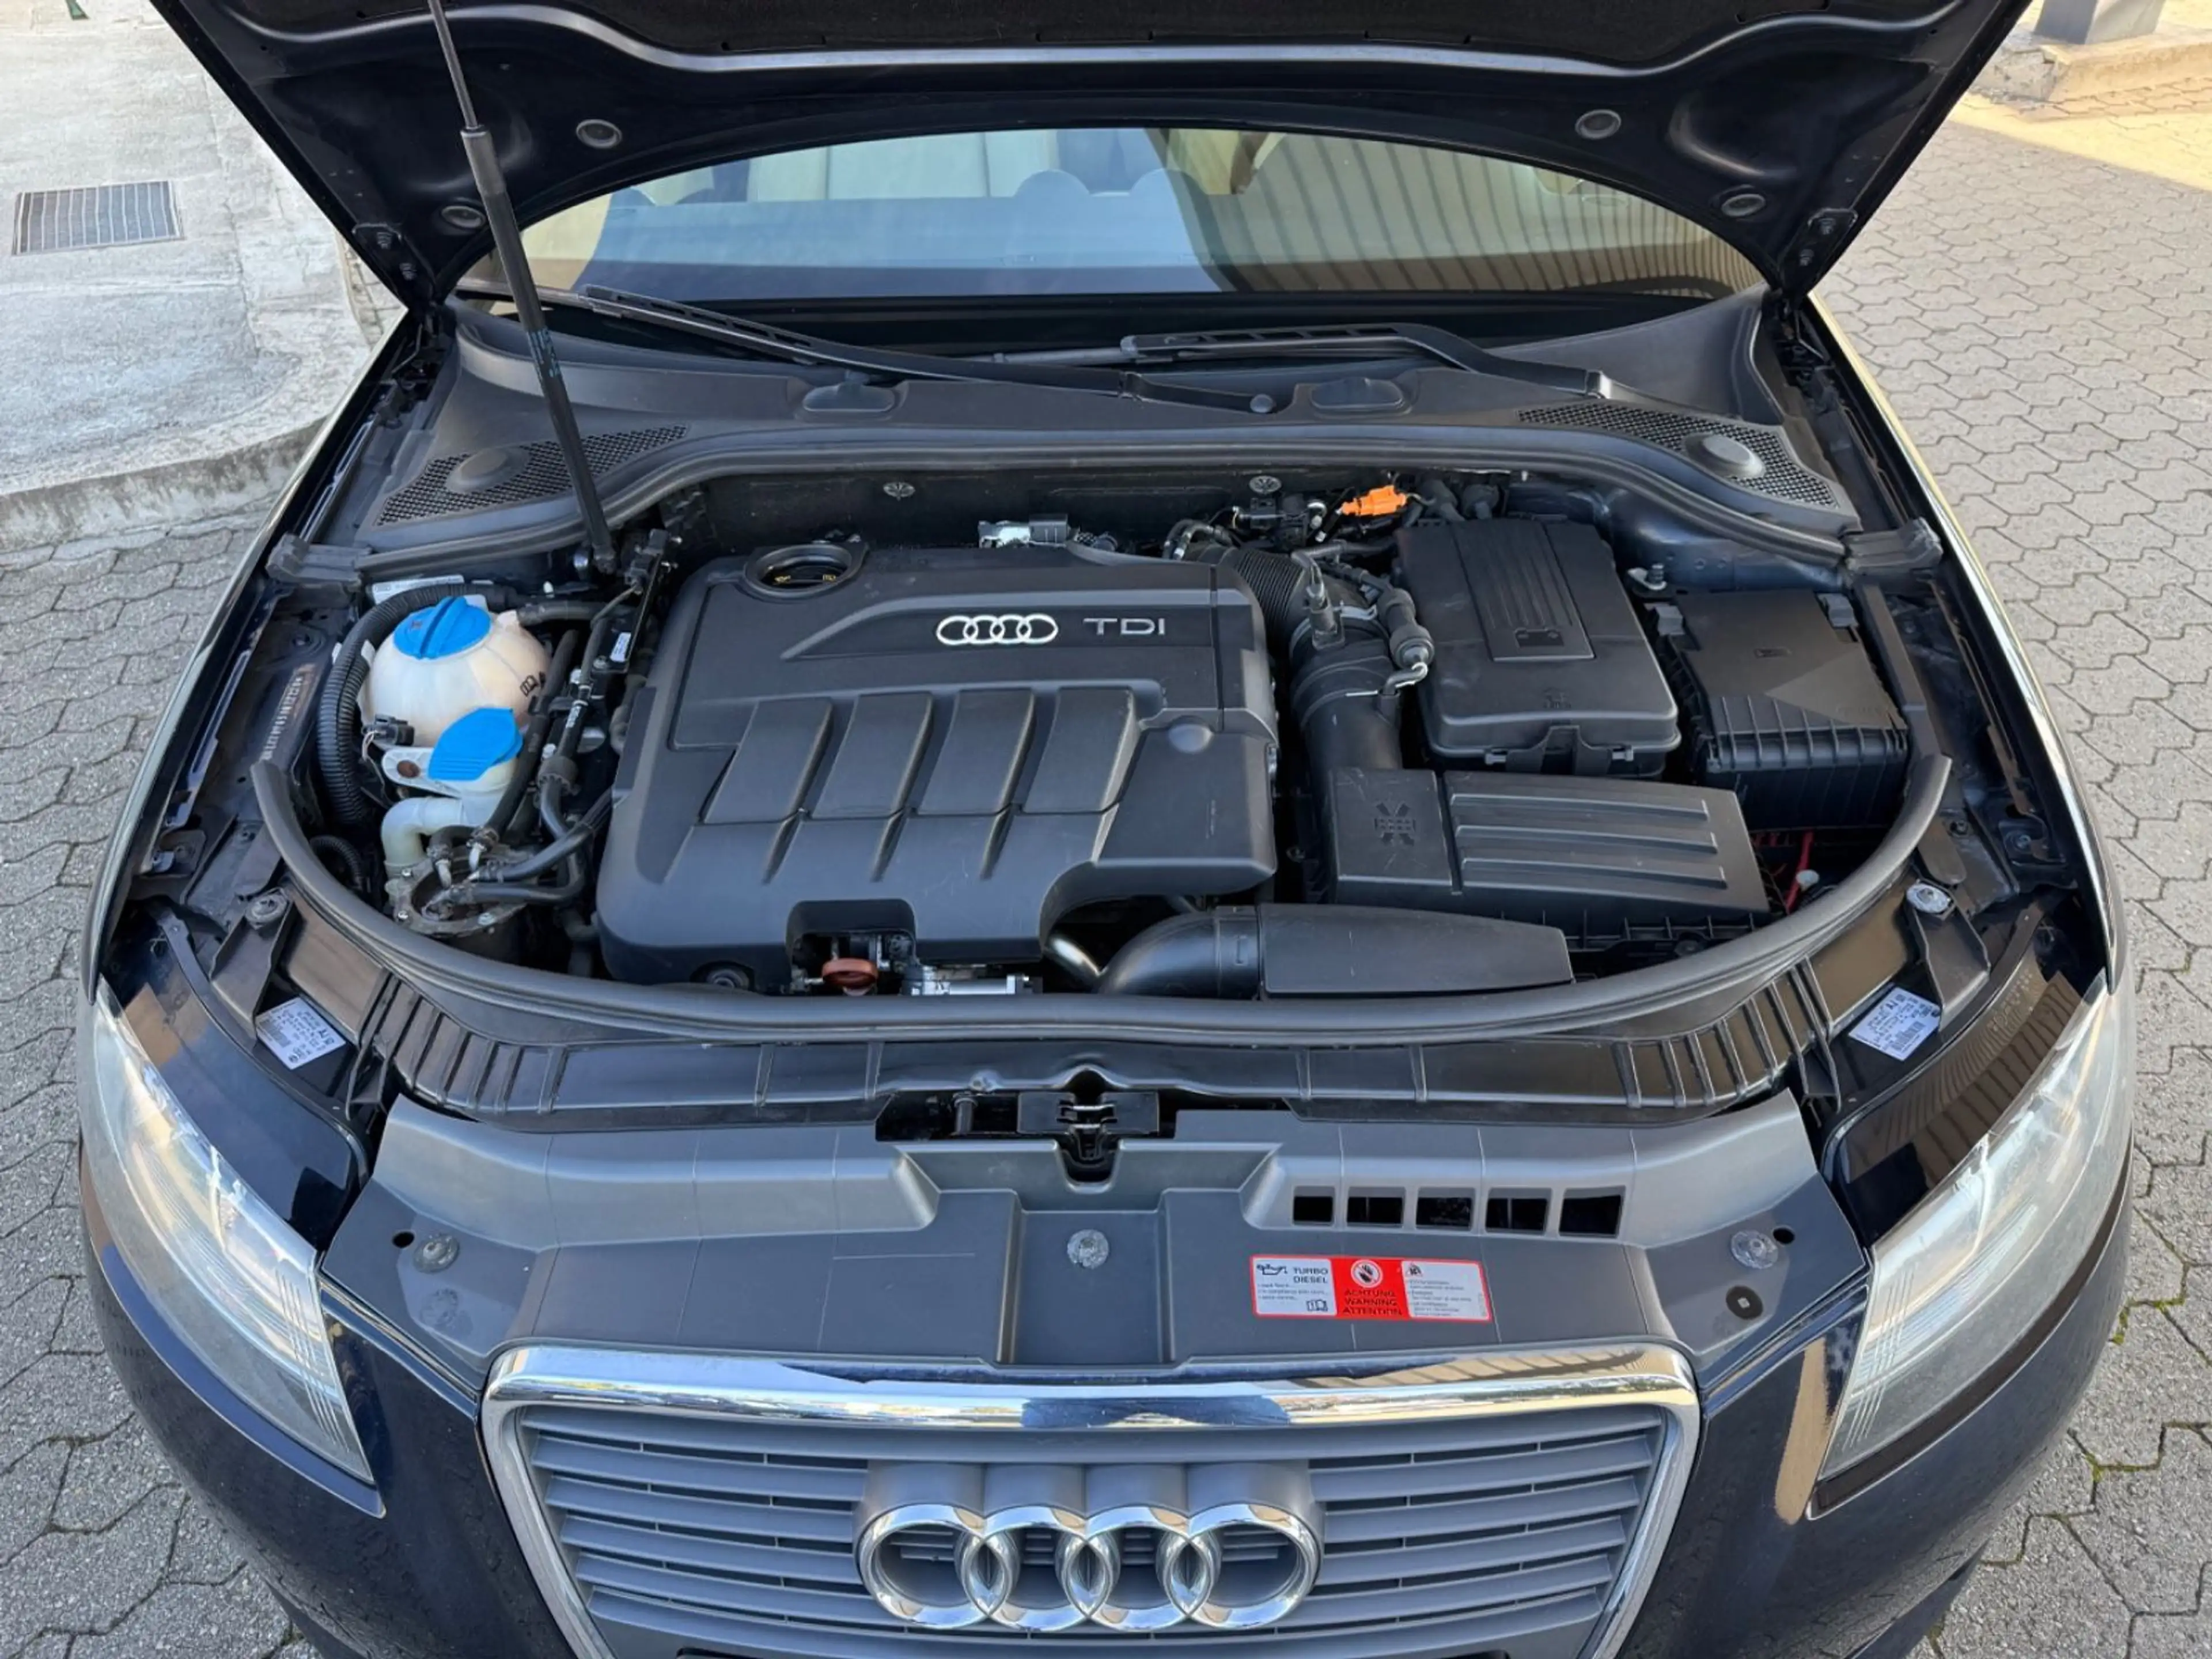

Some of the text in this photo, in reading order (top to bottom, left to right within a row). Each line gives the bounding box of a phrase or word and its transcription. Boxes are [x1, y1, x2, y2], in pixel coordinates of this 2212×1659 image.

[1083, 618, 1165, 636] TDI
[1293, 1275, 1328, 1283] DIESEL
[1345, 1298, 1398, 1306] WARNING
